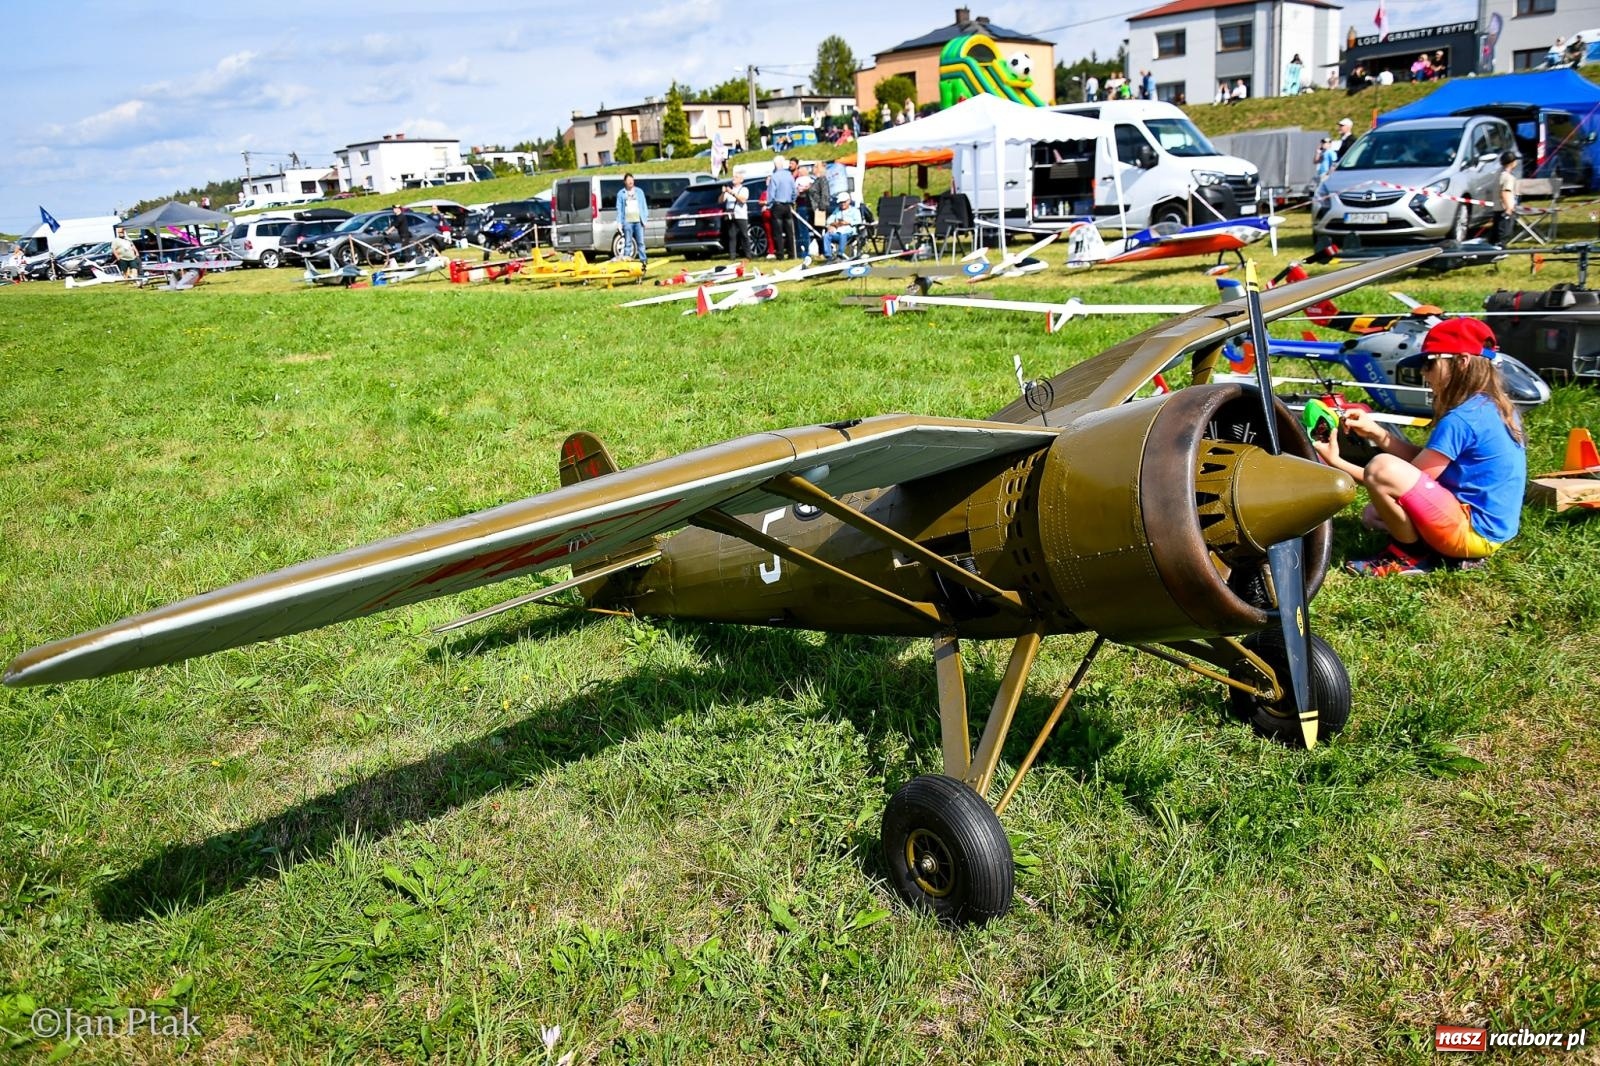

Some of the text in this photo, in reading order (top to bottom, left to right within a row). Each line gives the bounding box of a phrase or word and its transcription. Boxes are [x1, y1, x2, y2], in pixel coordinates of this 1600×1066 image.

[1357, 22, 1476, 47] LOD GRANITY FRYTKI
